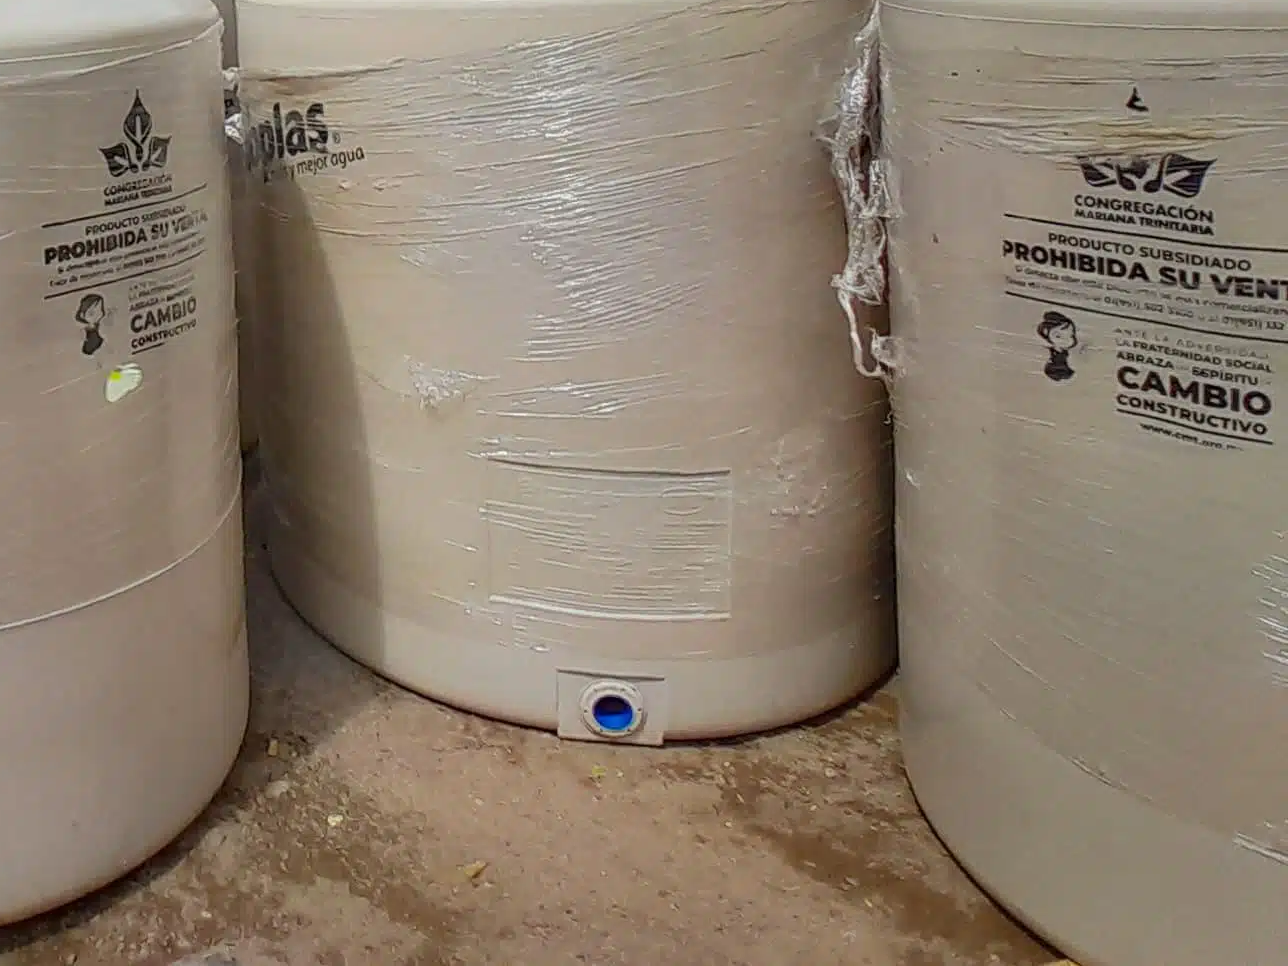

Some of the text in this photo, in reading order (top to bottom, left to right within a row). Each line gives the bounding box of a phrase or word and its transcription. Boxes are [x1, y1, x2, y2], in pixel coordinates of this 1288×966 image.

[297, 155, 328, 175] mejor
[330, 146, 365, 169] agua
[85, 216, 140, 236] PRODUCTO
[1074, 194, 1214, 223] CONGREGACIÓN
[1074, 208, 1215, 236] MARIANA TRINITARIA
[44, 228, 148, 265] PROHIBIDA
[151, 222, 169, 240] SU
[1048, 232, 1252, 272] PRODUCTO SUBSIDIADO
[1002, 239, 1150, 283] PROHIBIDA
[1158, 266, 1201, 290] SU
[130, 296, 197, 334] CAMBIO
[1116, 351, 1174, 371] ABRAZA
[1132, 340, 1222, 367] FRATERNIDAD
[1224, 357, 1274, 374] SOCIAL
[1116, 365, 1273, 416] CAMBIO
[1116, 393, 1268, 436] CONSTRUCTIVO
